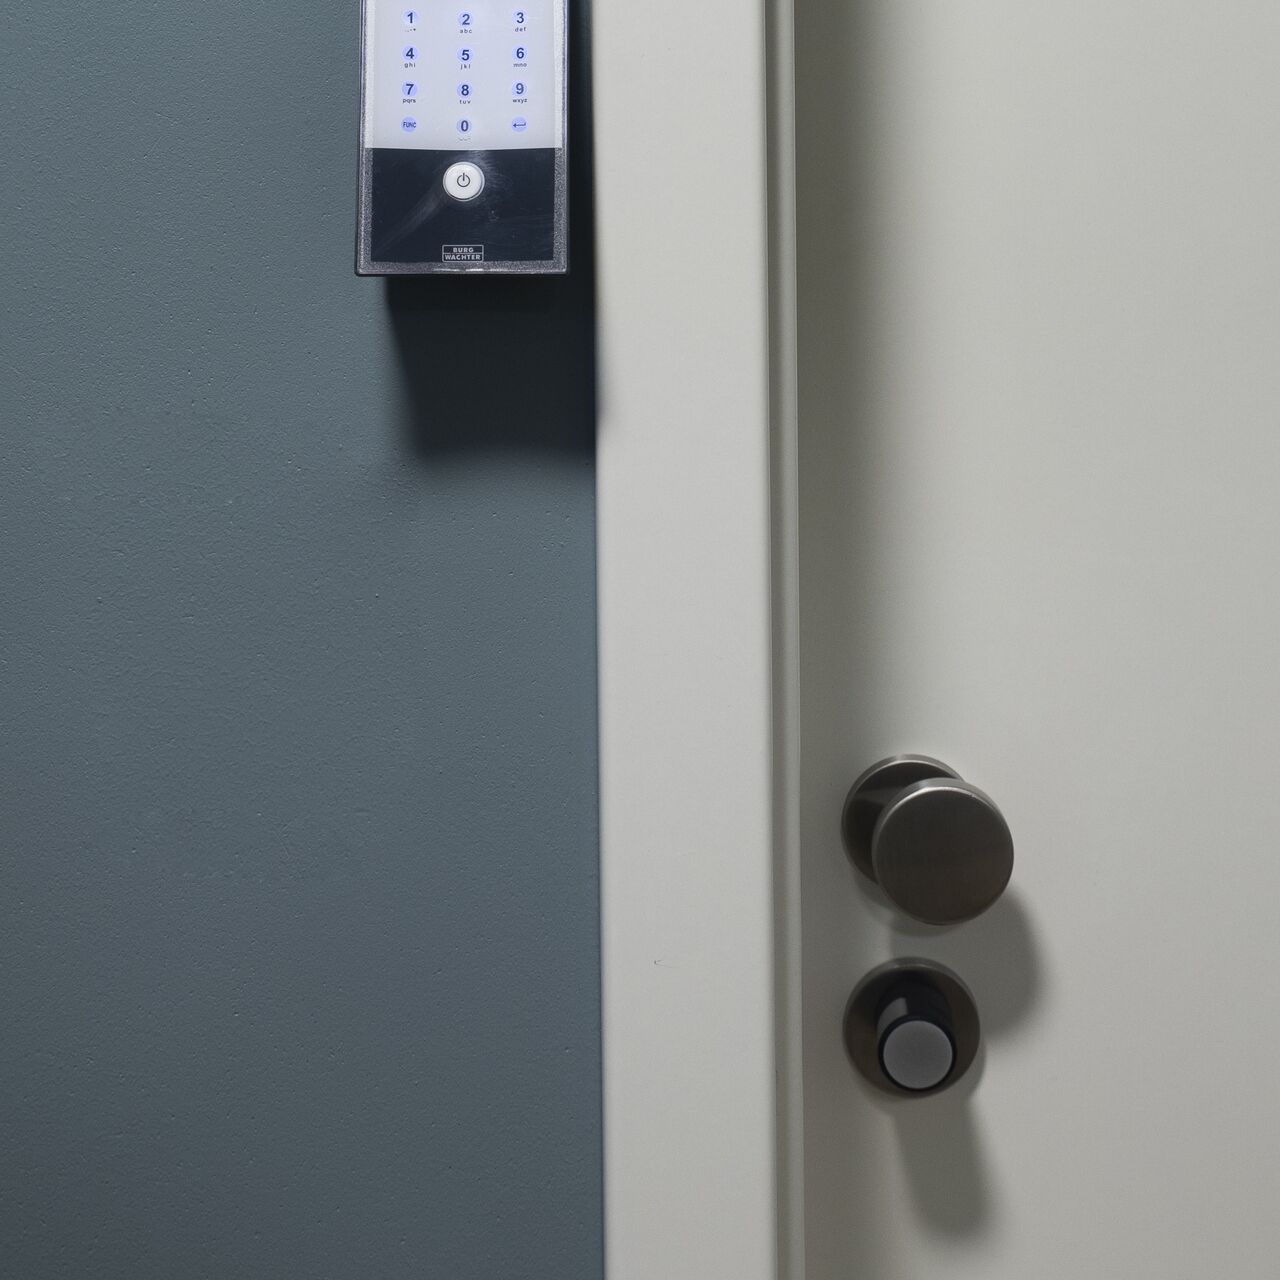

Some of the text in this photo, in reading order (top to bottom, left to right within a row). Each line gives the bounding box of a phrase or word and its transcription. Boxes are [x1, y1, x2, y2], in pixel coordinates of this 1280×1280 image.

[407, 12, 413, 24] 1
[462, 14, 470, 25] 2
[516, 12, 524, 23] 3
[406, 48, 414, 59] 4
[462, 50, 470, 61] 5
[516, 48, 524, 59] 6
[406, 84, 414, 95] 7
[461, 85, 469, 96] 8
[516, 83, 524, 94] 9
[461, 120, 469, 132] 0
